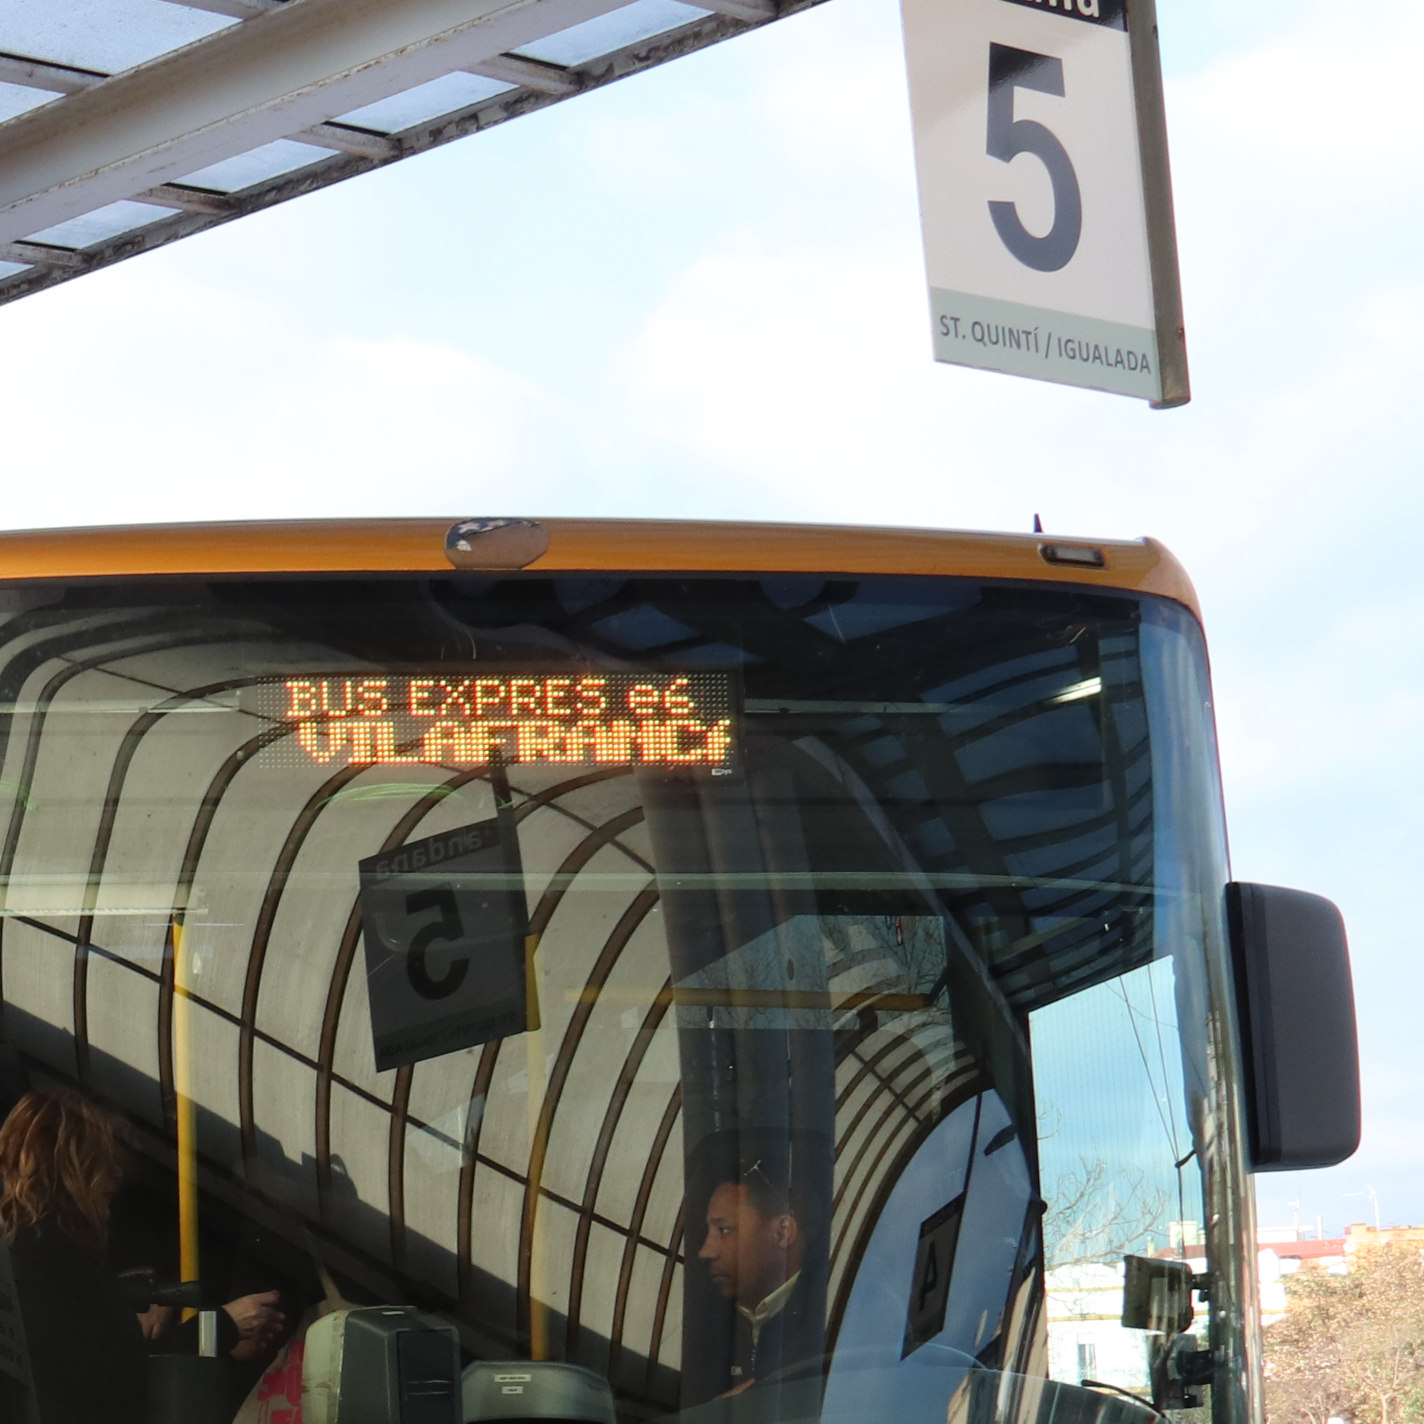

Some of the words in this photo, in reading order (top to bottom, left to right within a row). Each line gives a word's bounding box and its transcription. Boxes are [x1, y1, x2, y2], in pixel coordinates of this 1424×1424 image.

[986, 42, 1082, 272] 5
[940, 315, 966, 340] ST.
[971, 321, 1039, 354] QUINTÍ
[1058, 337, 1151, 375] IGUALADA
[284, 680, 388, 717] BUS
[409, 679, 605, 717] EXPRES
